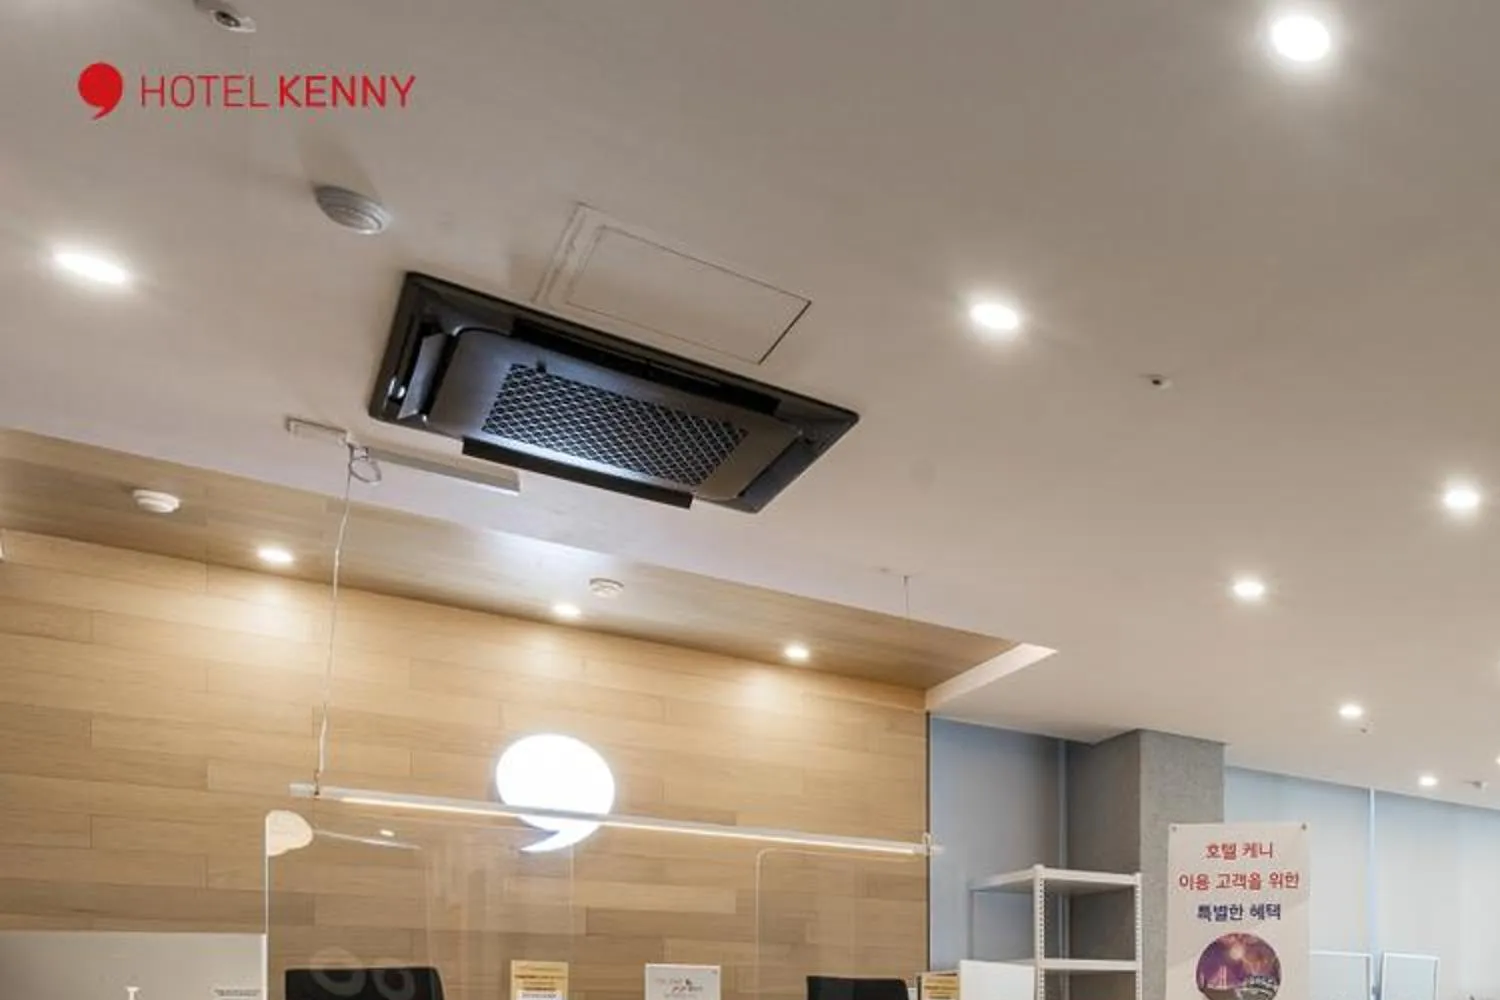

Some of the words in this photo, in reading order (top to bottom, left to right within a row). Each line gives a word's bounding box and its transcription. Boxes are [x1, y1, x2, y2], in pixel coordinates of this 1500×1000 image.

[1206, 842, 1237, 861] 호텔
[1242, 841, 1273, 859] 케니
[1179, 873, 1211, 891] 이용
[1216, 872, 1262, 891] 고객을
[1268, 871, 1300, 889] 위한
[1197, 903, 1244, 922] 특별한
[1250, 903, 1281, 921] 혜택
